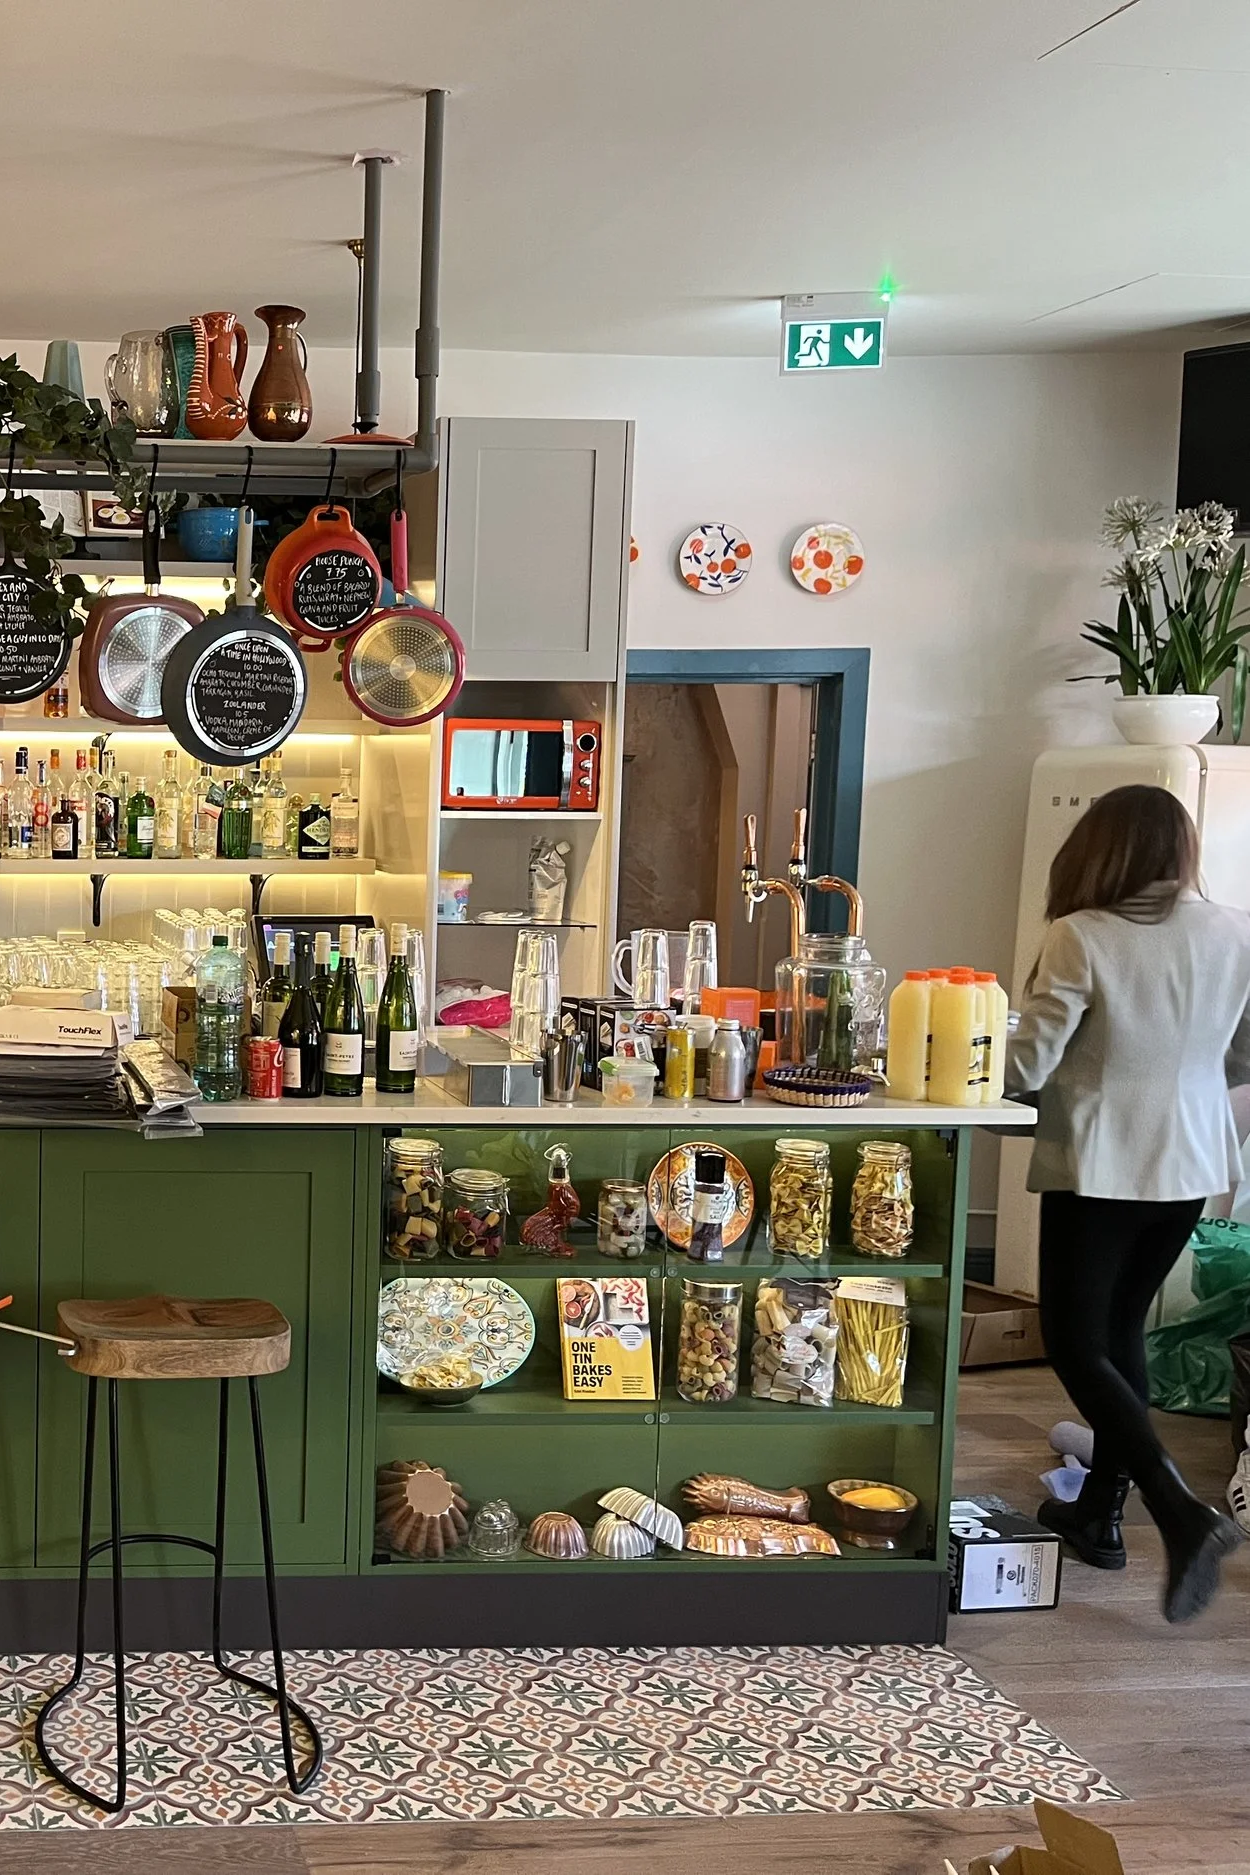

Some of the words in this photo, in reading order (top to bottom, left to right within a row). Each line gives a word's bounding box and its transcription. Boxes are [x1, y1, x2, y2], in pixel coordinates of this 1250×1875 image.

[10, 582, 28, 592] AND
[307, 583, 331, 595] BLEND
[2, 592, 20, 602] CITY
[322, 604, 337, 613] AND
[7, 635, 13, 643] A
[13, 634, 28, 644] GUY
[235, 642, 251, 652] ONCE
[252, 644, 269, 653] UPON
[226, 650, 241, 660] TIME
[223, 700, 266, 711] ZOOLANDER
[1052, 796, 1098, 806] SM
[58, 1025, 102, 1035] TouchFlex
[571, 1342, 596, 1352] ONE
[572, 1354, 592, 1364] TIN
[573, 1365, 612, 1375] BAKES
[573, 1377, 603, 1387] EASY
